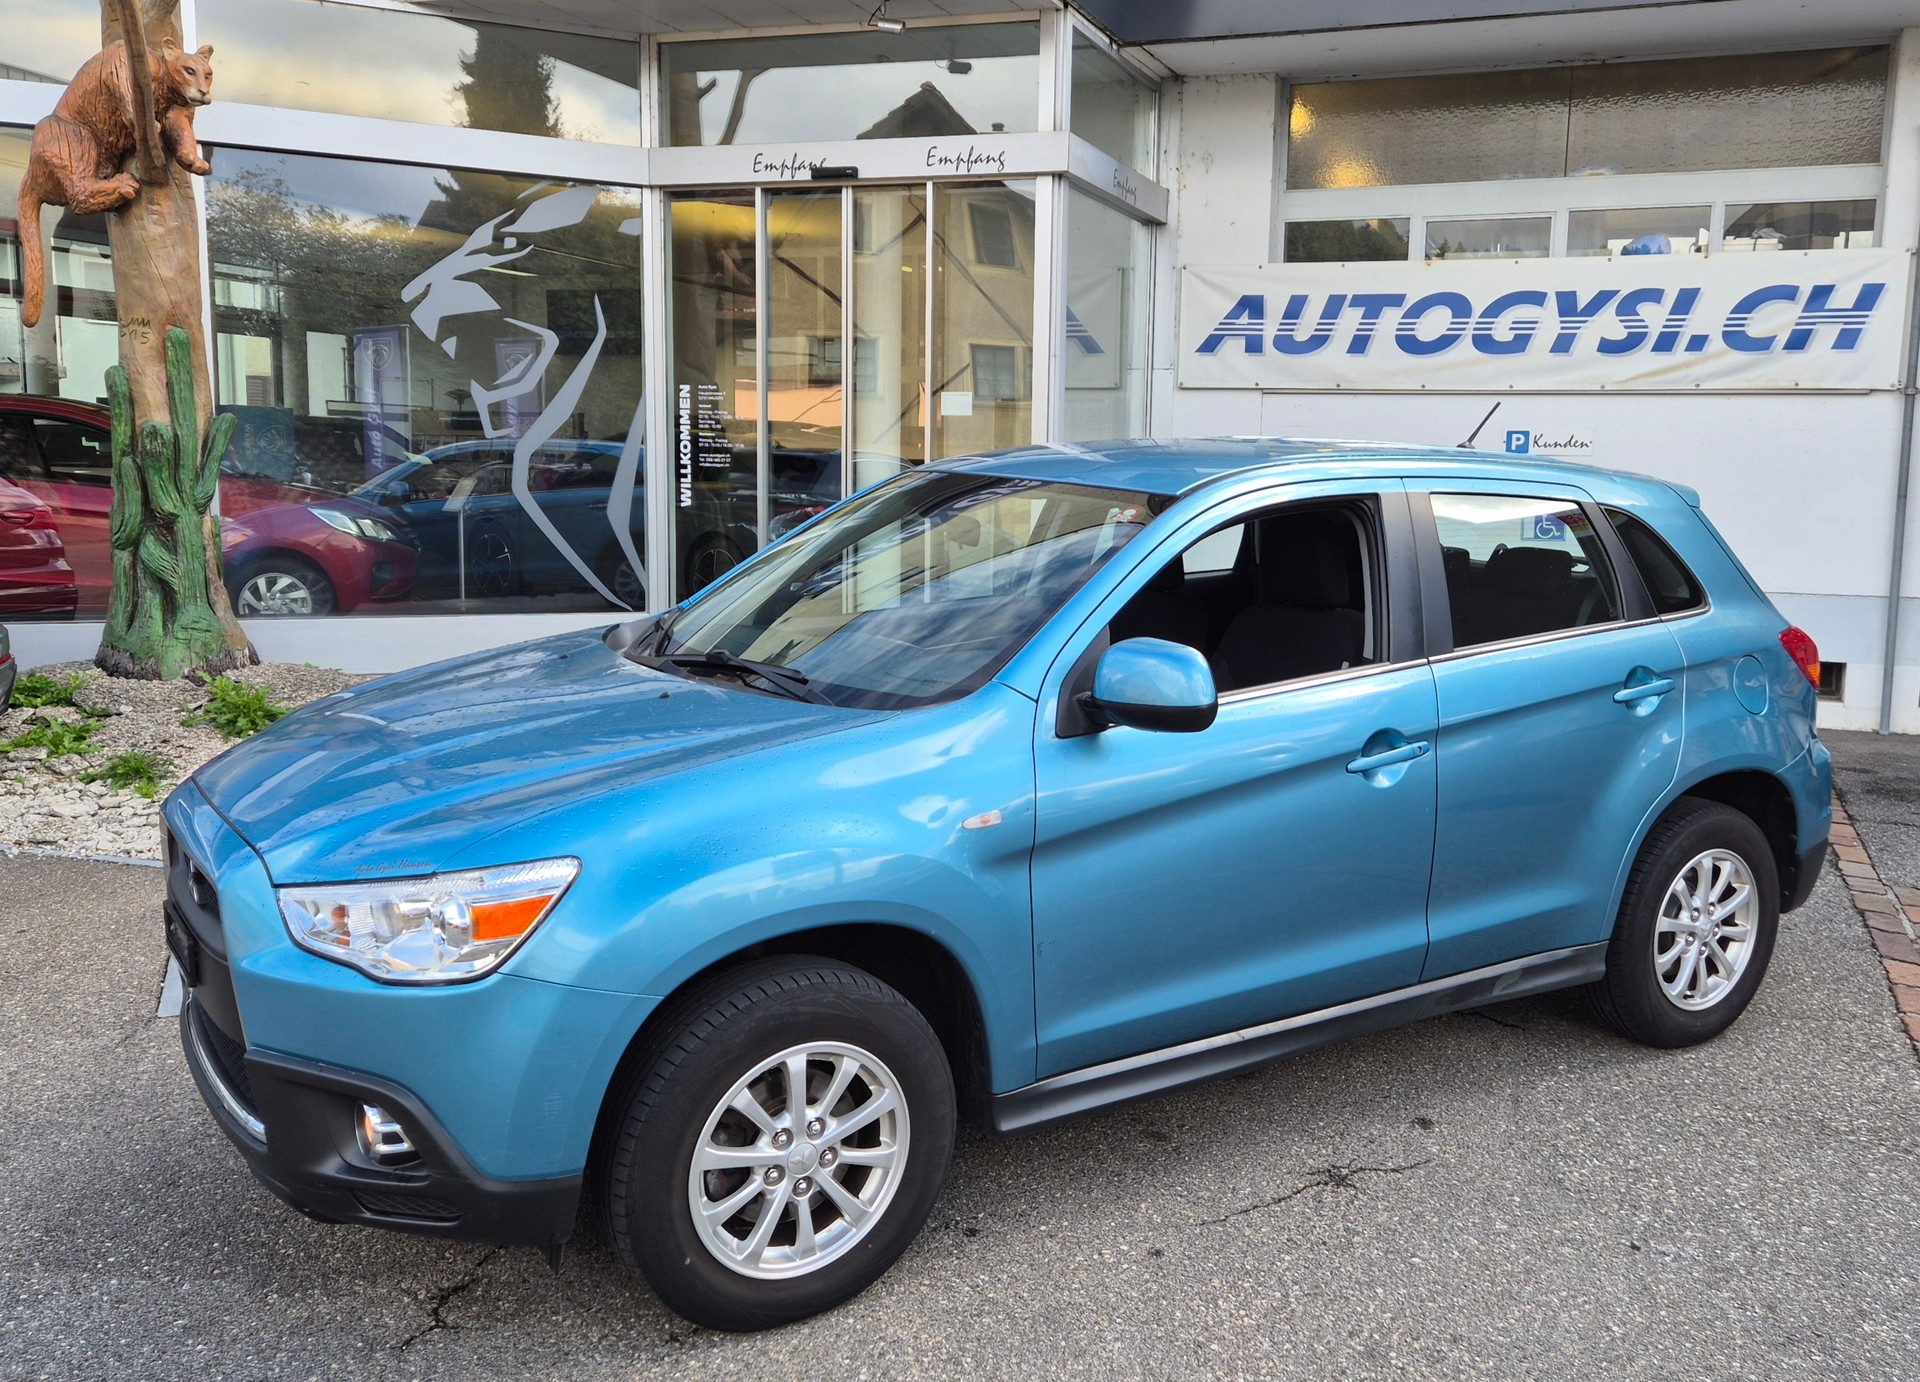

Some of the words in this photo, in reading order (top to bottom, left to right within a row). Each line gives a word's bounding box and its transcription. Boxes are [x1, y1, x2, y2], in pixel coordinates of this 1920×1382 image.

[926, 145, 1006, 173] Empfang
[1194, 282, 1887, 355] AUTOGYSI.CH
[679, 384, 692, 507] WILLKOMMEN
[1532, 433, 1590, 449] Kunden
